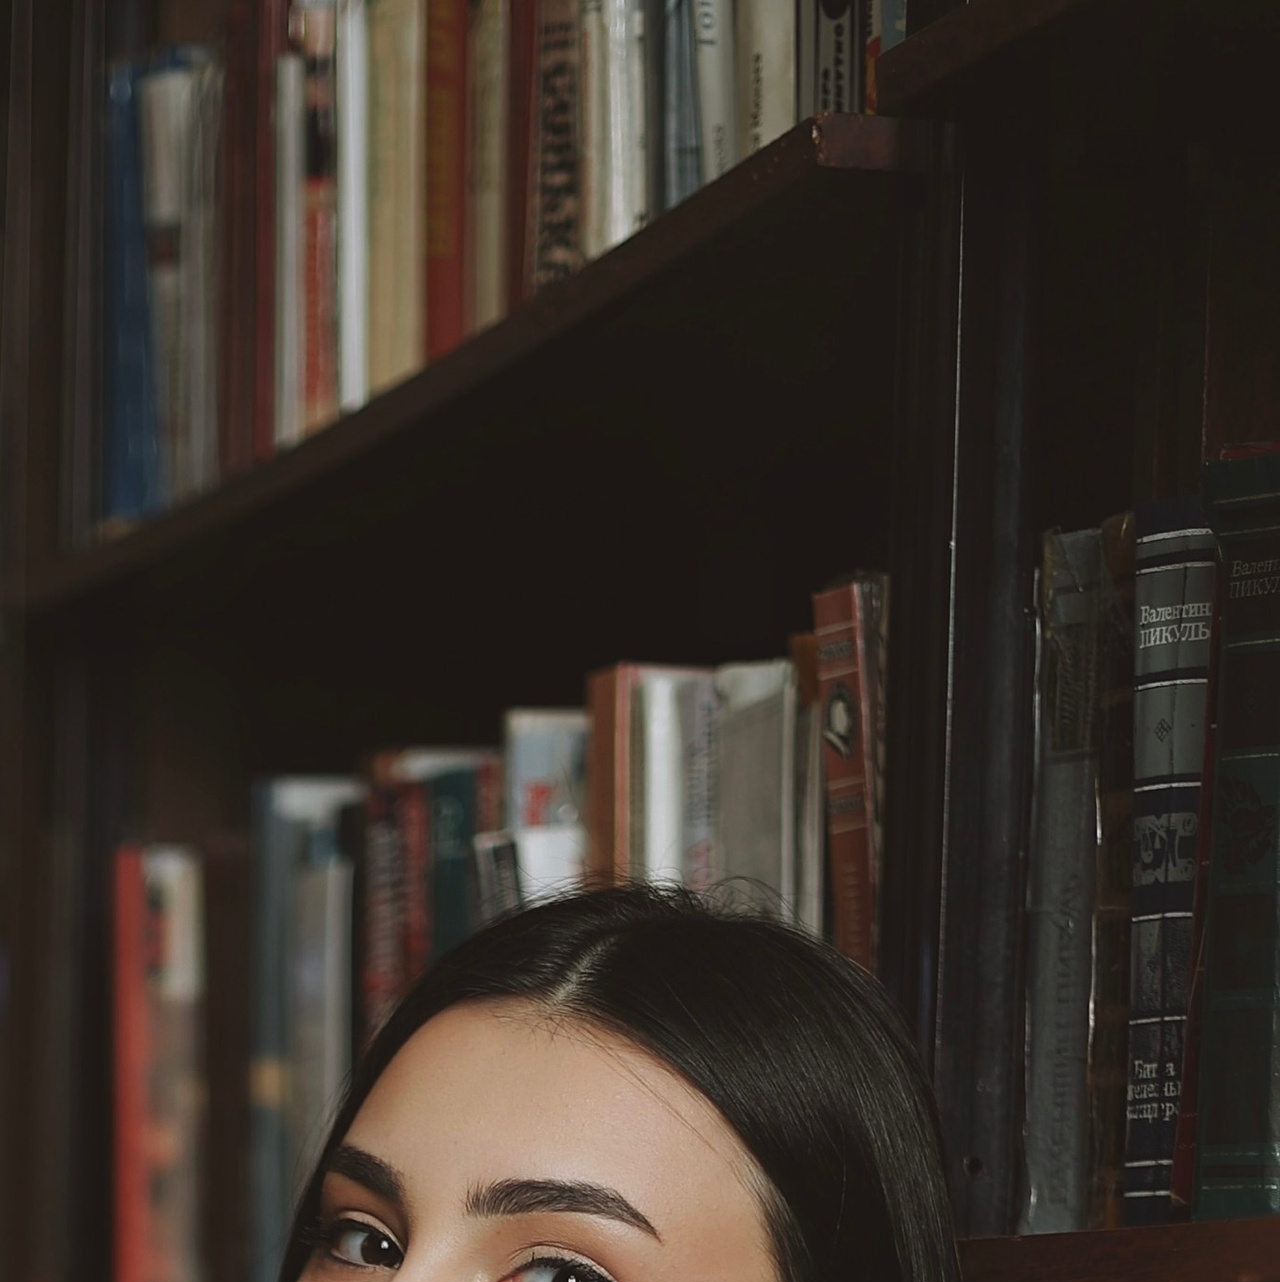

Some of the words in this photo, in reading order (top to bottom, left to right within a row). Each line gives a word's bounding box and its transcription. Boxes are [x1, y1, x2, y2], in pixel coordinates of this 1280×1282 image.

[1229, 559, 1280, 577] Валент
[1140, 602, 1213, 625] Валентин
[1140, 621, 1211, 649] ПИКУЛЬ
